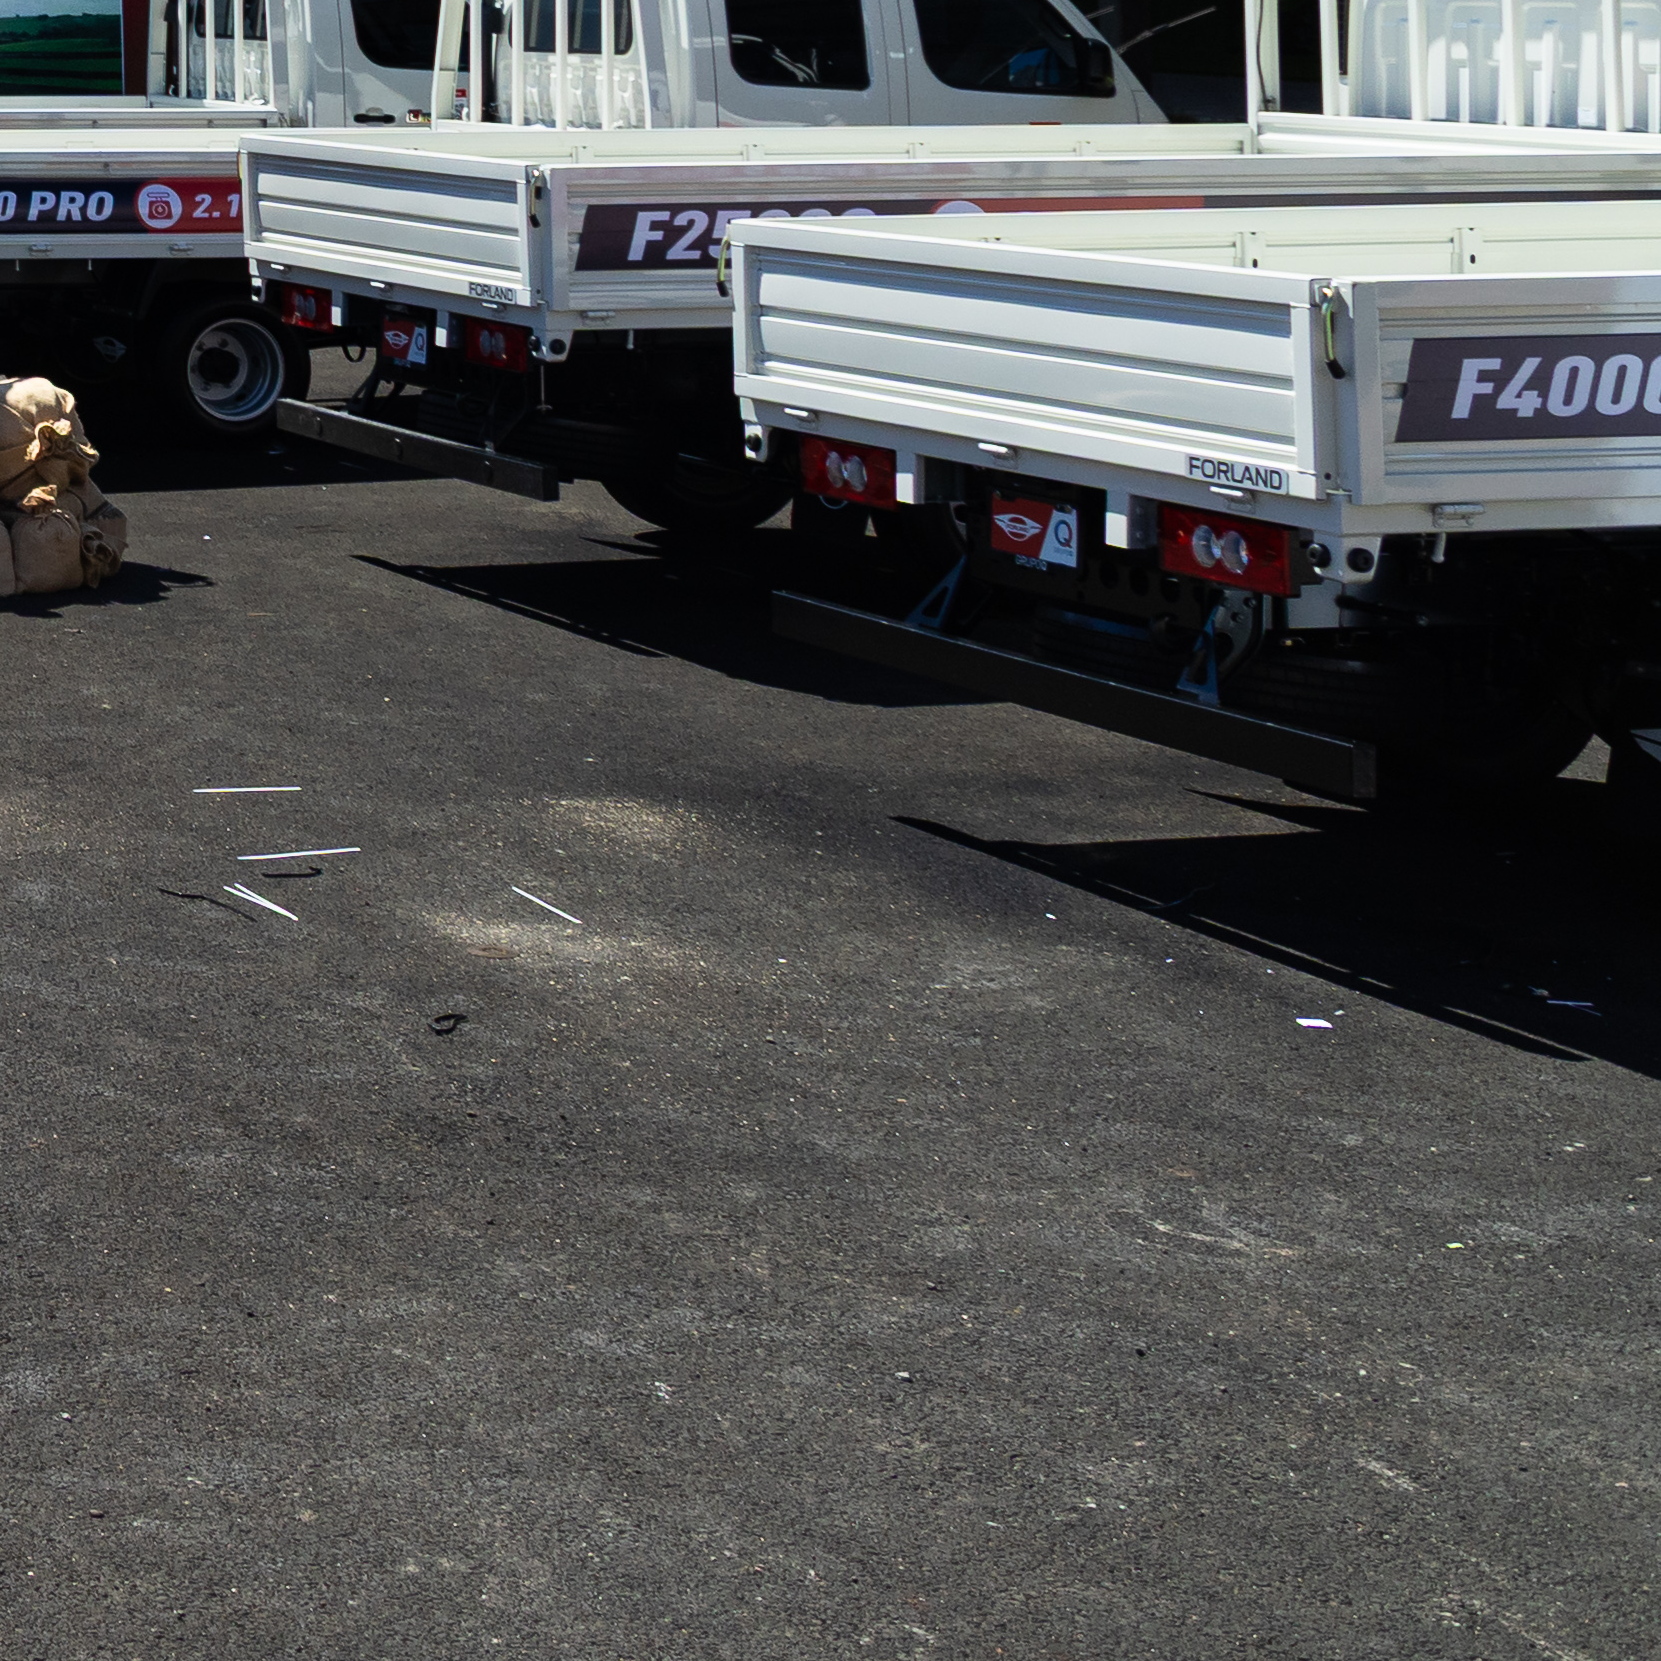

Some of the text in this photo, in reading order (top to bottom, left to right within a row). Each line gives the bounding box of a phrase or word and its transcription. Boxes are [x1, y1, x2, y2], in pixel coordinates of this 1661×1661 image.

[27, 191, 114, 221] PRO
[469, 281, 514, 302] FORLAND
[1188, 456, 1283, 490] FORLAND
[1054, 519, 1073, 549] Q
